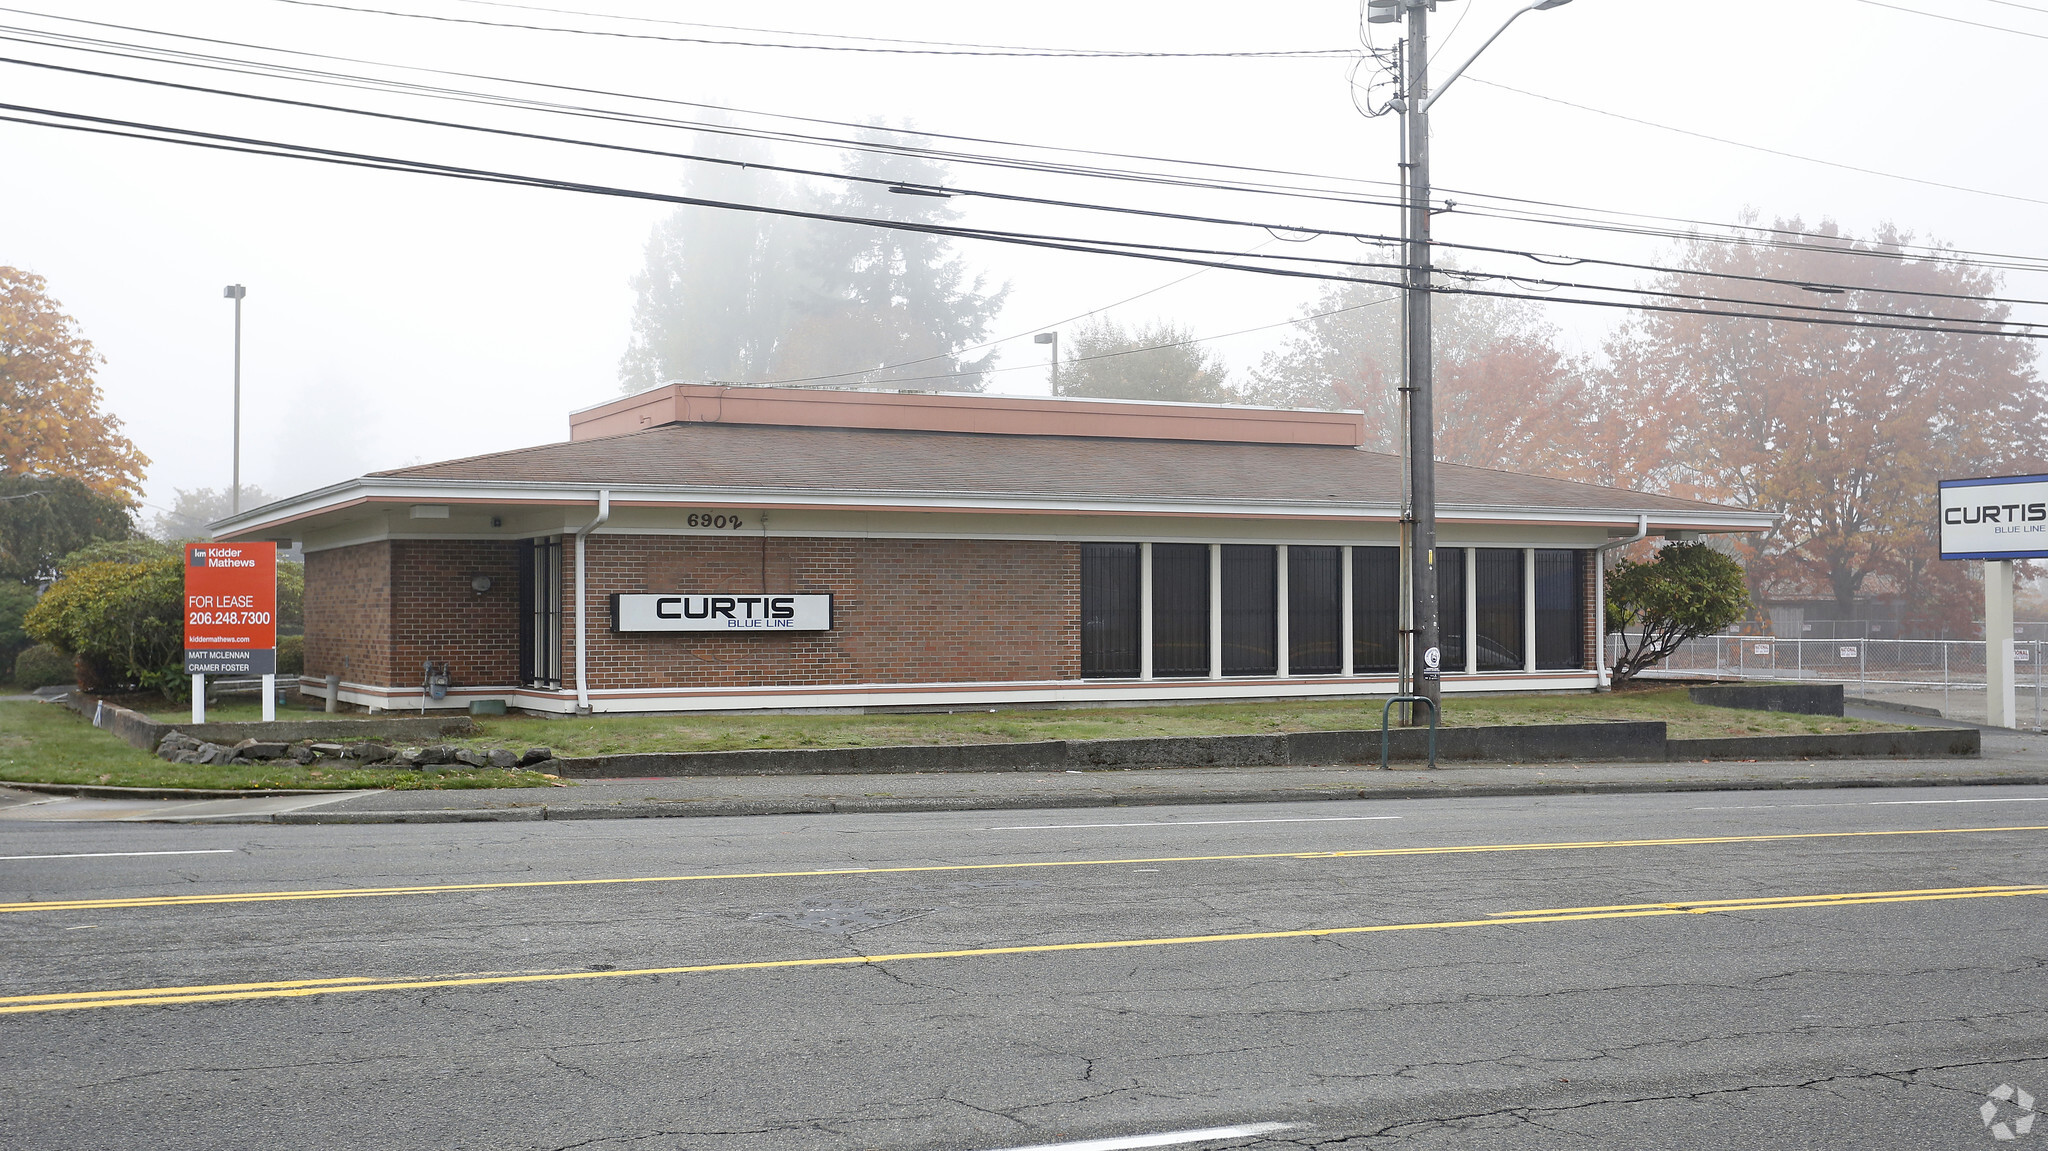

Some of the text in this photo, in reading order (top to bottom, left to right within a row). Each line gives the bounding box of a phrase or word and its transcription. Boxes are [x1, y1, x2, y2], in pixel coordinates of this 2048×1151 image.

[1945, 503, 2047, 525] CURTIS
[687, 513, 743, 530] 6902
[1994, 525, 2046, 534] BLUE LINE
[194, 548, 207, 558] km
[208, 548, 242, 558] Kidder
[208, 558, 256, 568] Mathews
[189, 595, 254, 608] FOR LEASE
[656, 597, 795, 619] CURTIS
[189, 611, 271, 625] 206.248.7300
[727, 619, 794, 628] BLUE LINE
[189, 635, 250, 643] kiddermathews.com
[188, 651, 250, 659] MATT MCLENNAN
[188, 663, 250, 672] CRAMER FOSTER
